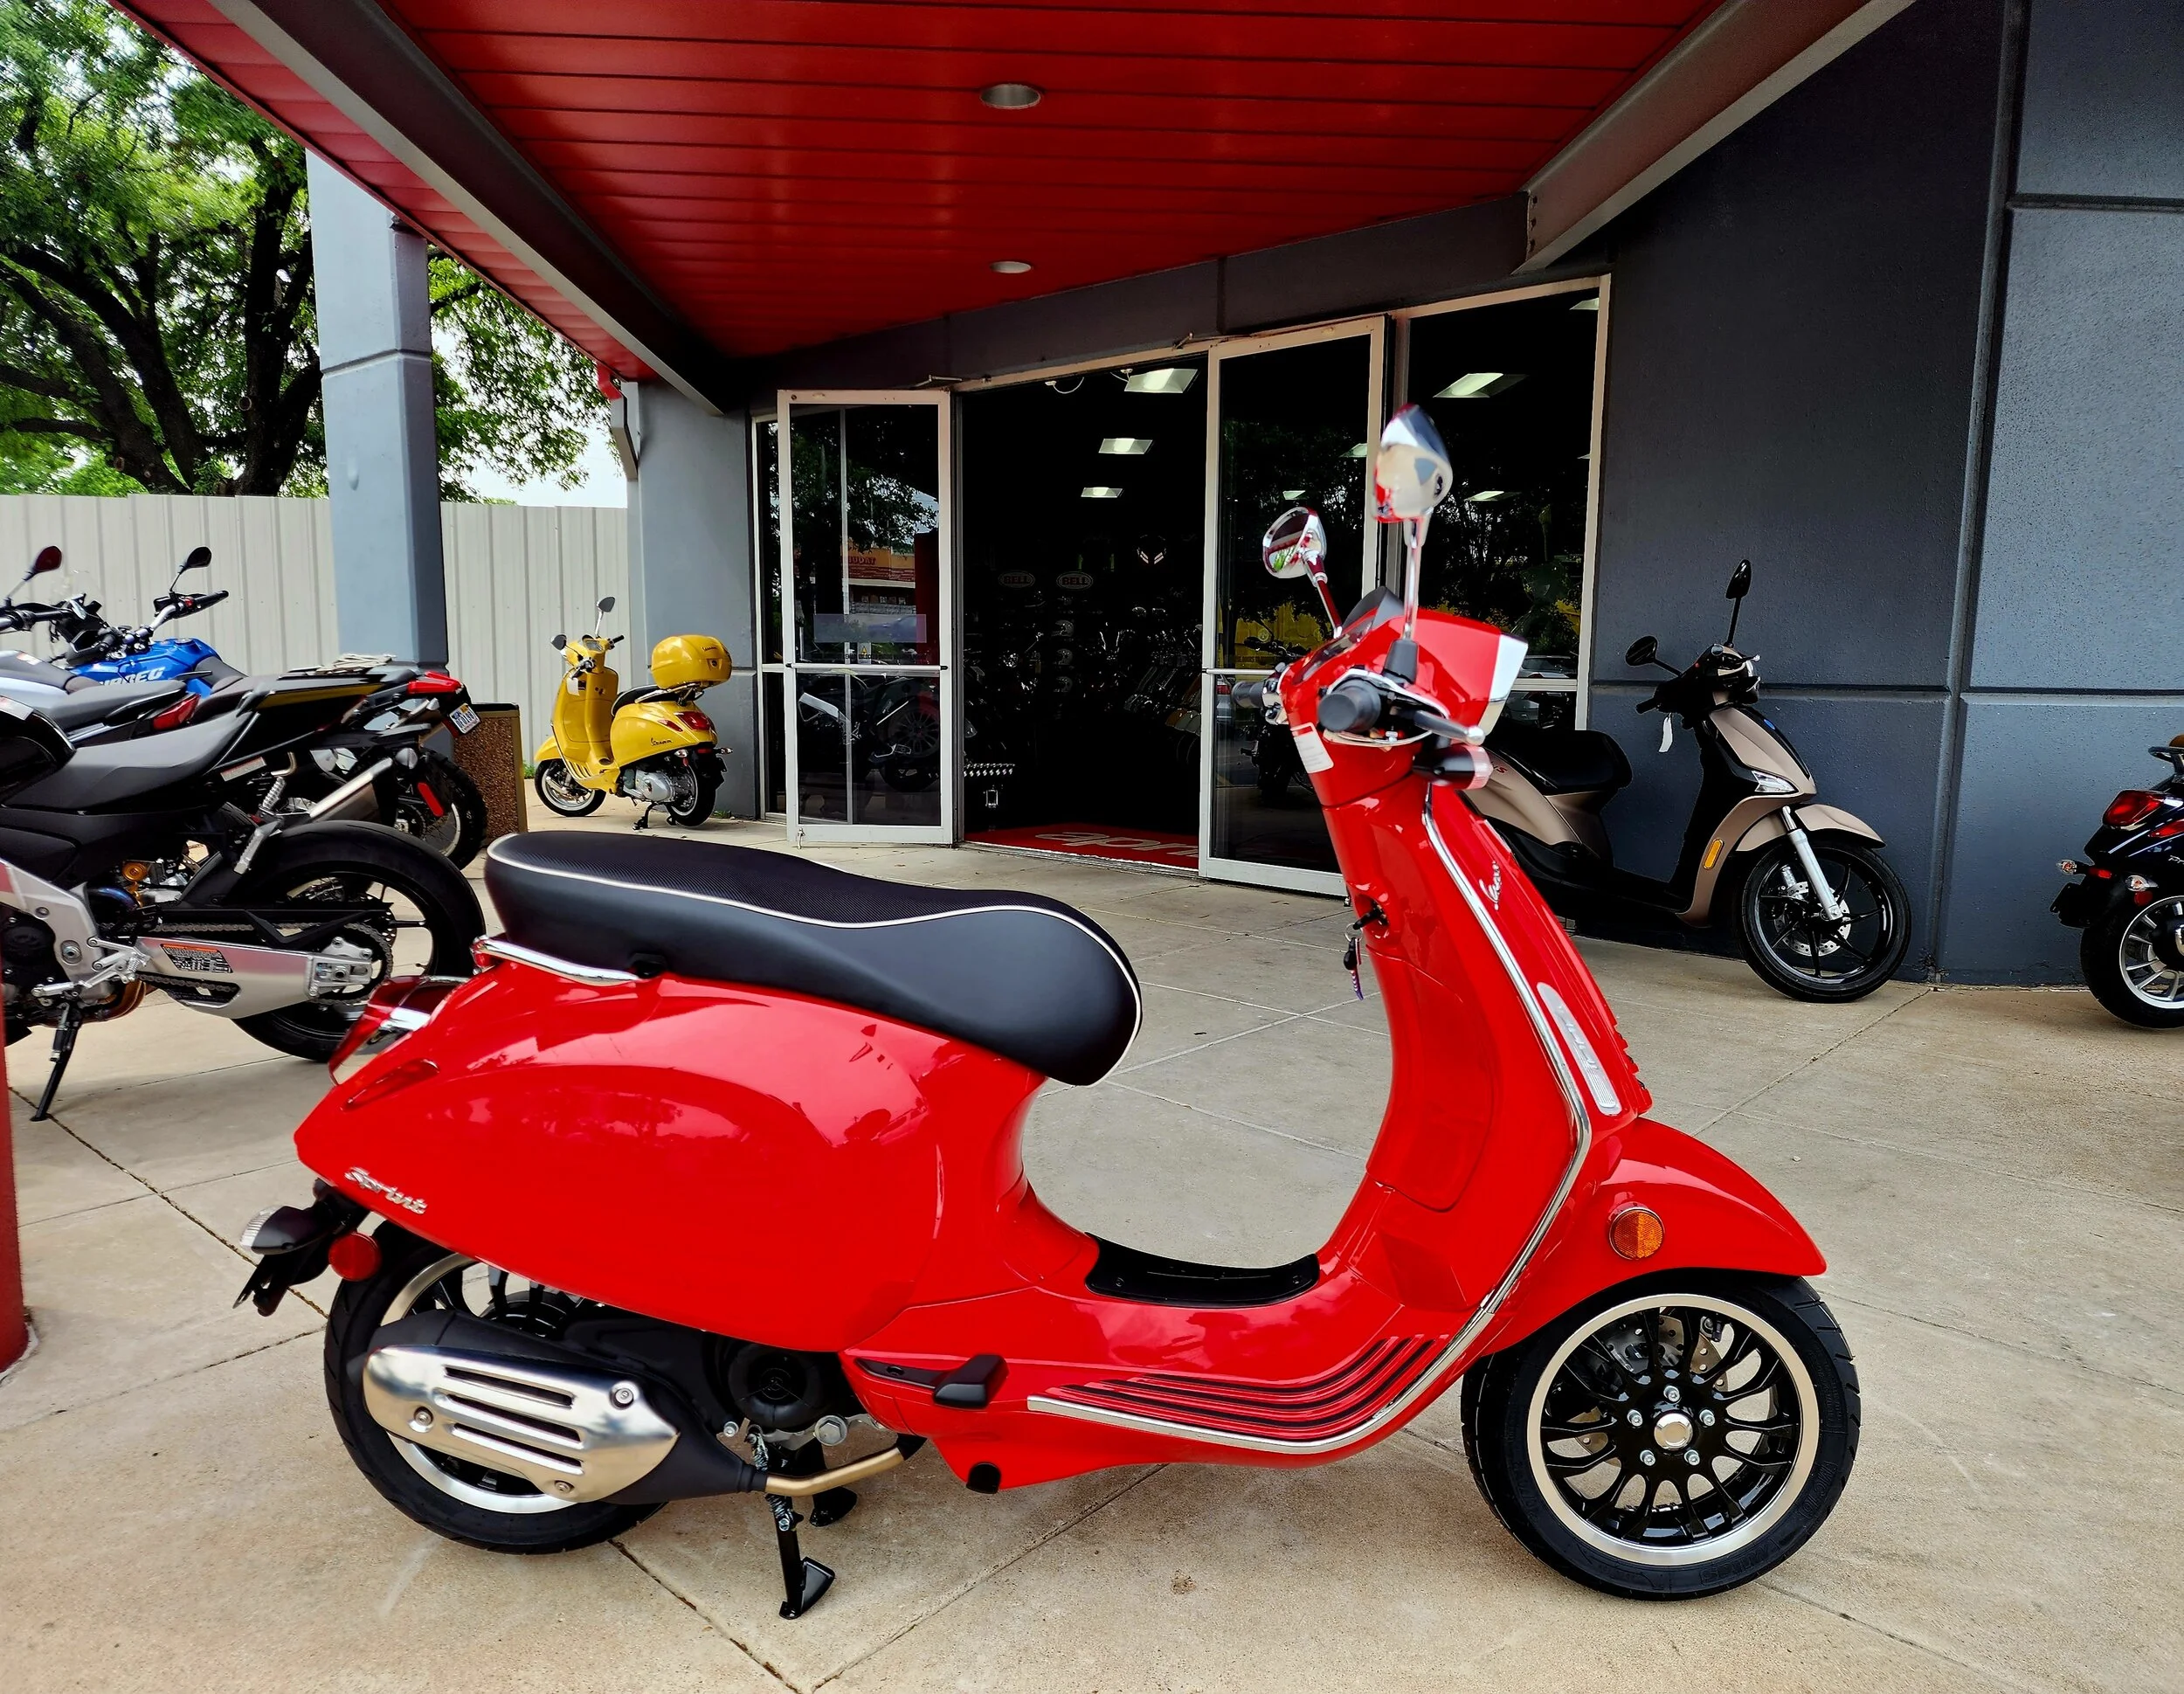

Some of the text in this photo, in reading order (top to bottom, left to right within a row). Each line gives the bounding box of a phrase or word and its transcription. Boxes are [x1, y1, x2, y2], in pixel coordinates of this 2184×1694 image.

[1004, 576, 1029, 584] BELL
[1061, 577, 1088, 585] BELL
[1034, 832, 1199, 857] apri
[343, 1166, 428, 1215] Sprint
